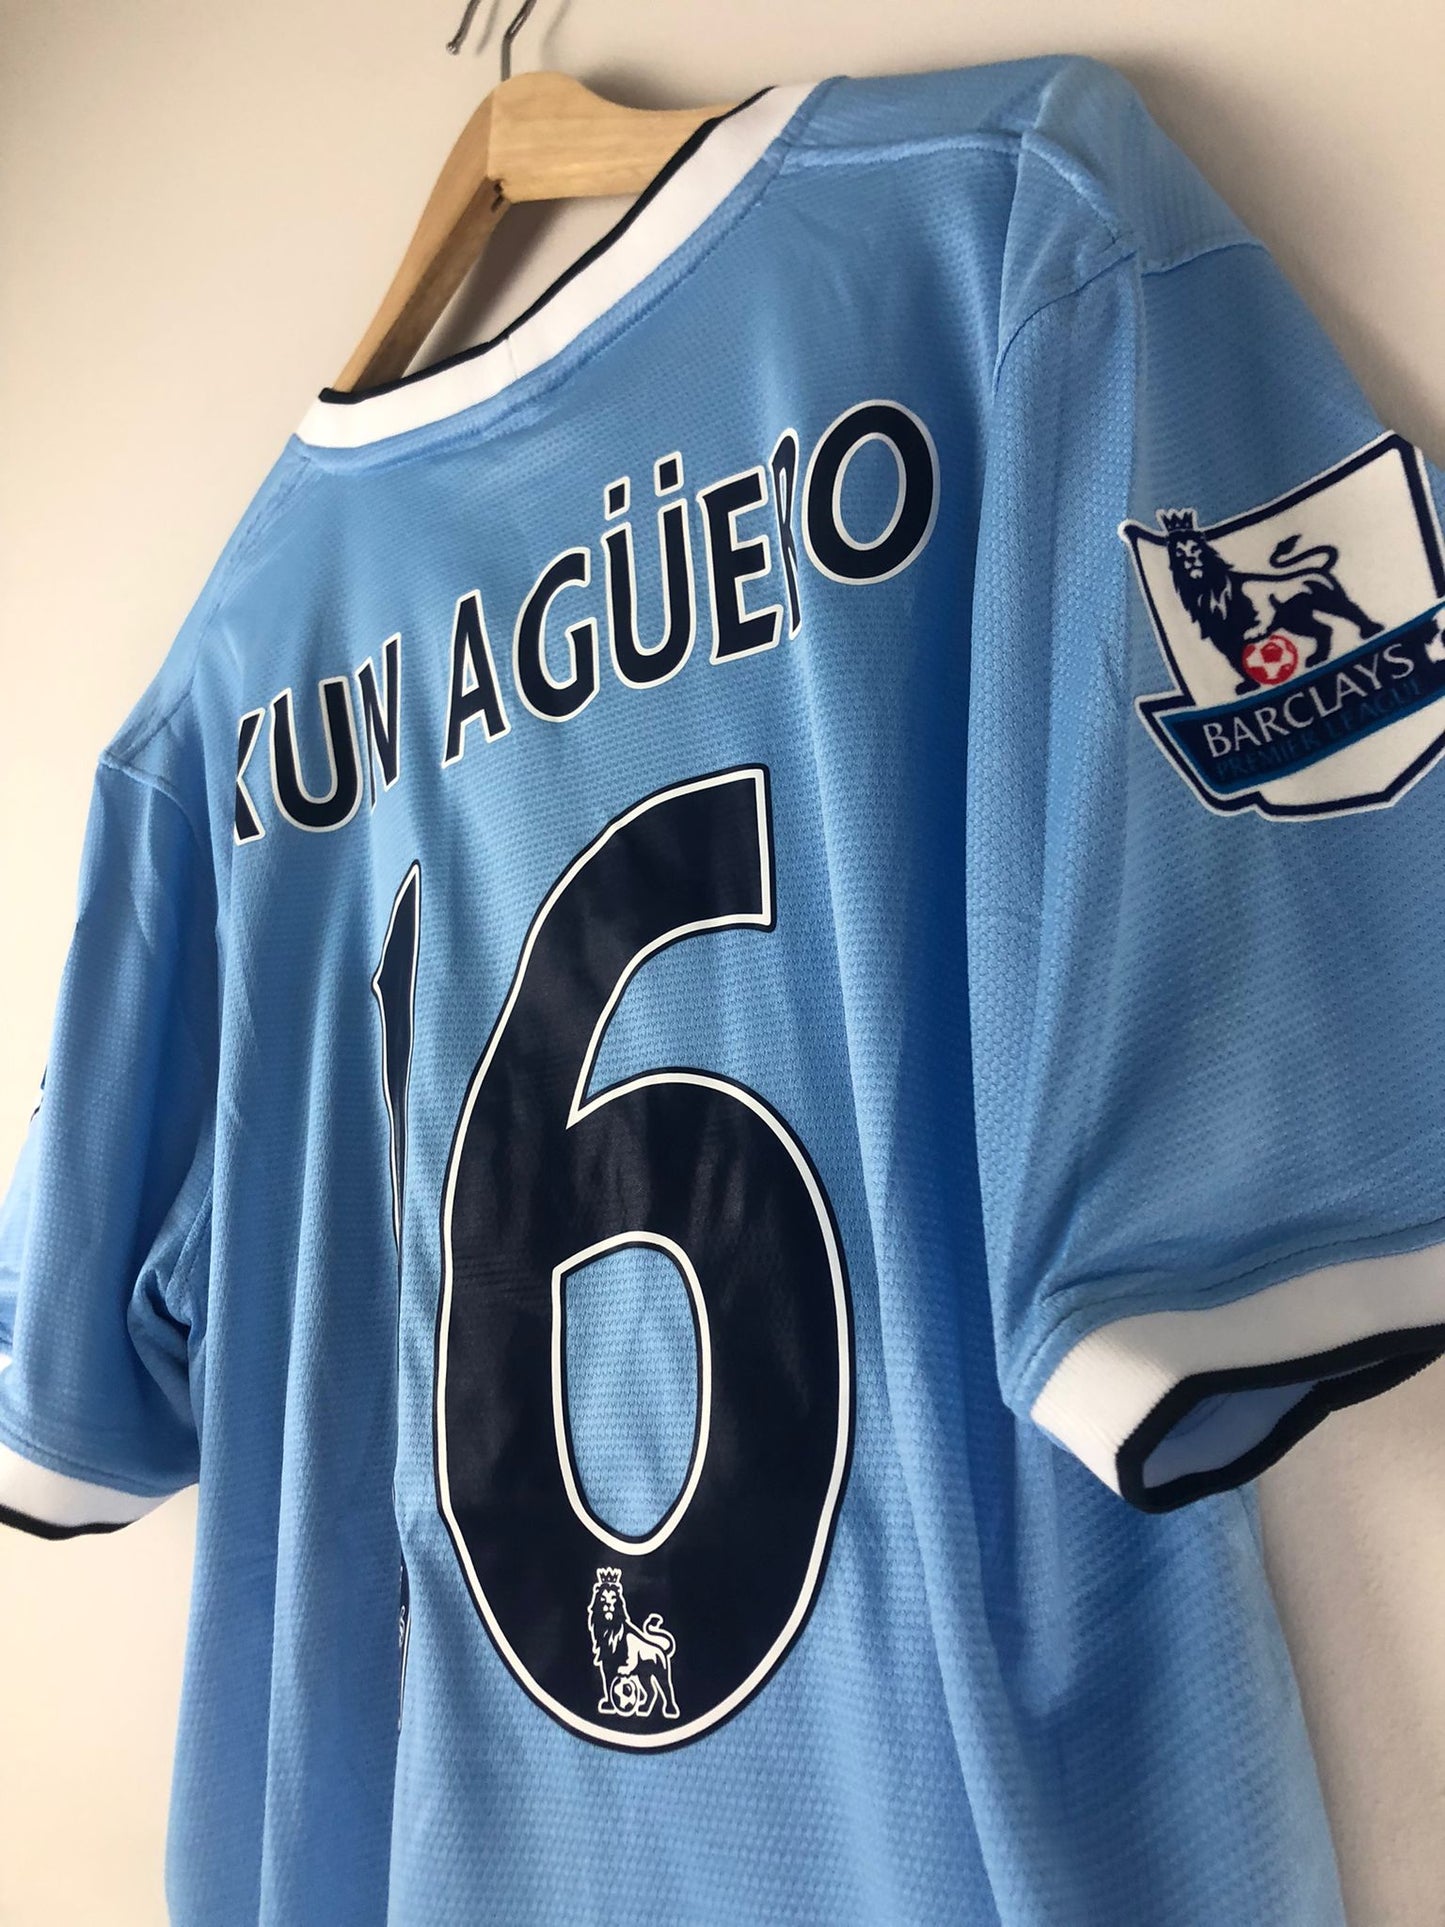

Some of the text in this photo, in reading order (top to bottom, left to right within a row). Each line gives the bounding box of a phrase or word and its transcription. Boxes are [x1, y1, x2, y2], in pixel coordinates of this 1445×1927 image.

[233, 399, 941, 846] KUN AGÜERO
[1202, 642, 1415, 758] BARCLAYS
